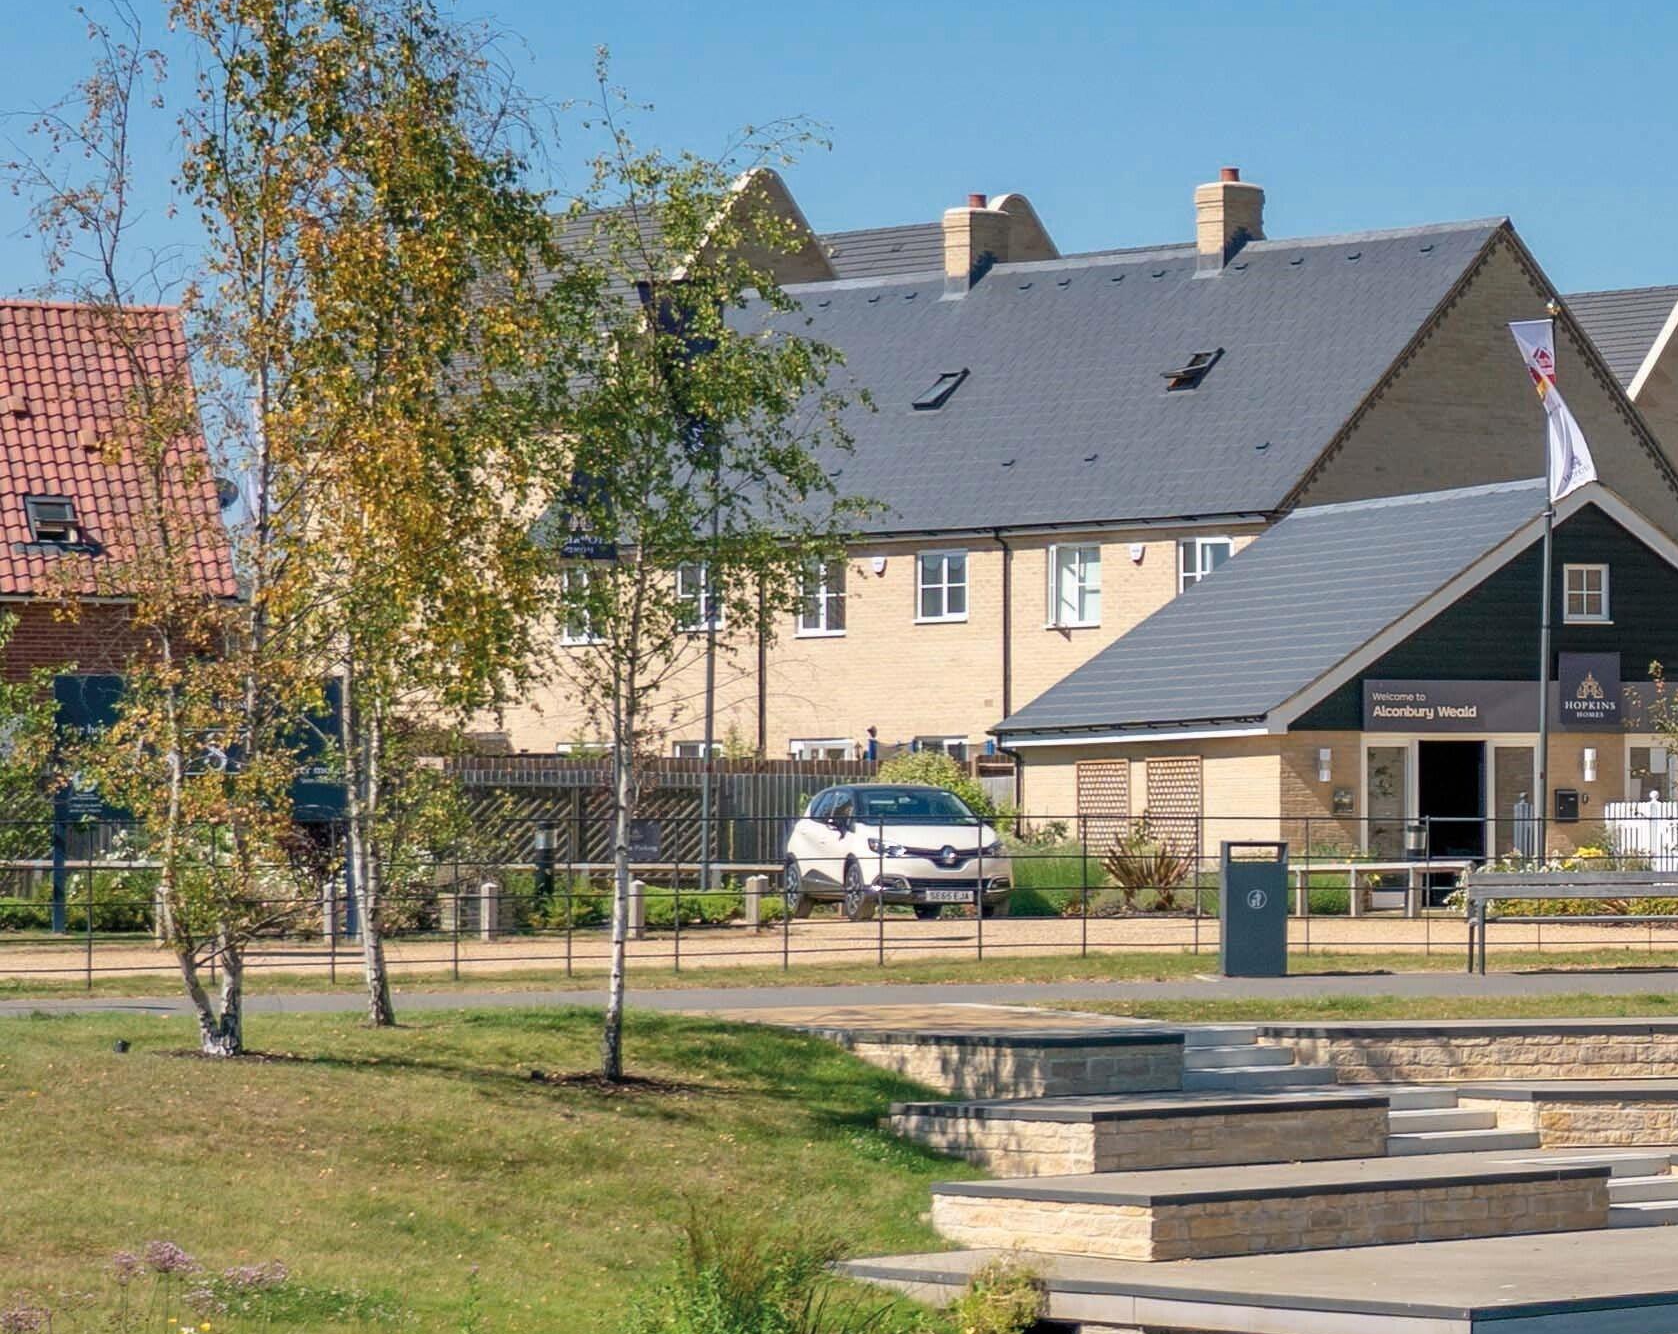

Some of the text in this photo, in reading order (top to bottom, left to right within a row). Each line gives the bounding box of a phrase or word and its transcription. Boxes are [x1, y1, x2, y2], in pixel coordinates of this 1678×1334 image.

[1372, 692, 1426, 701] Welcome to
[1564, 700, 1616, 710] HOPKINS
[1372, 706, 1477, 719] Alconbury Weald
